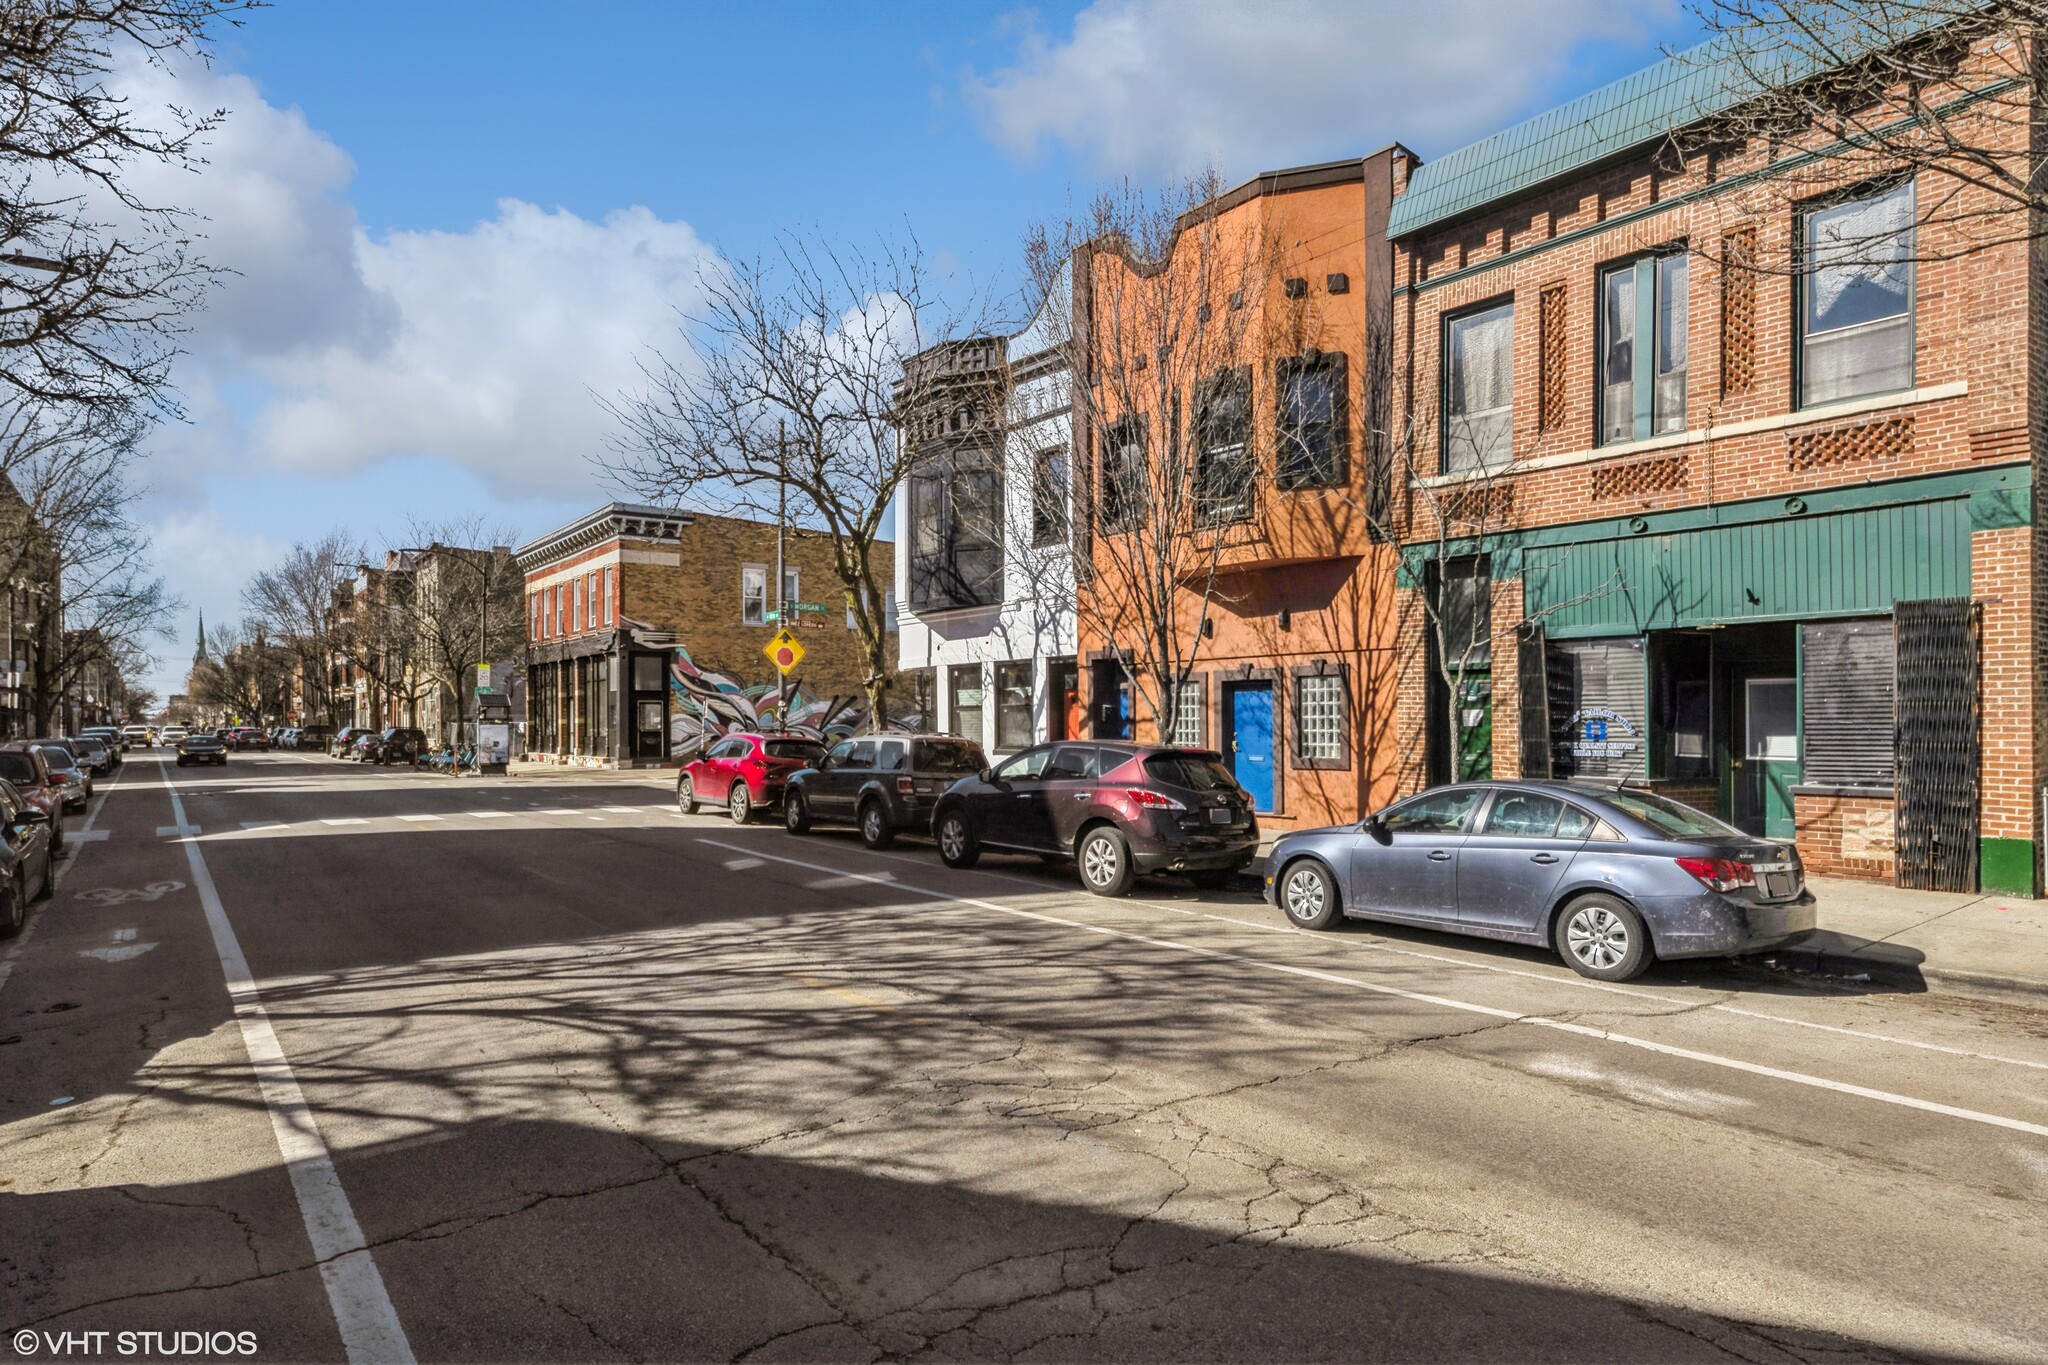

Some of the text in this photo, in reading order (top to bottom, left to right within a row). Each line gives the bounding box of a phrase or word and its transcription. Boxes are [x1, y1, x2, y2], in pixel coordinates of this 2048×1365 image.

[794, 603, 820, 611] MORGAN
[1582, 708, 1638, 736] TAILOR SHOP
[1579, 742, 1607, 751] QUALITY
[1607, 742, 1636, 751] SERVICE
